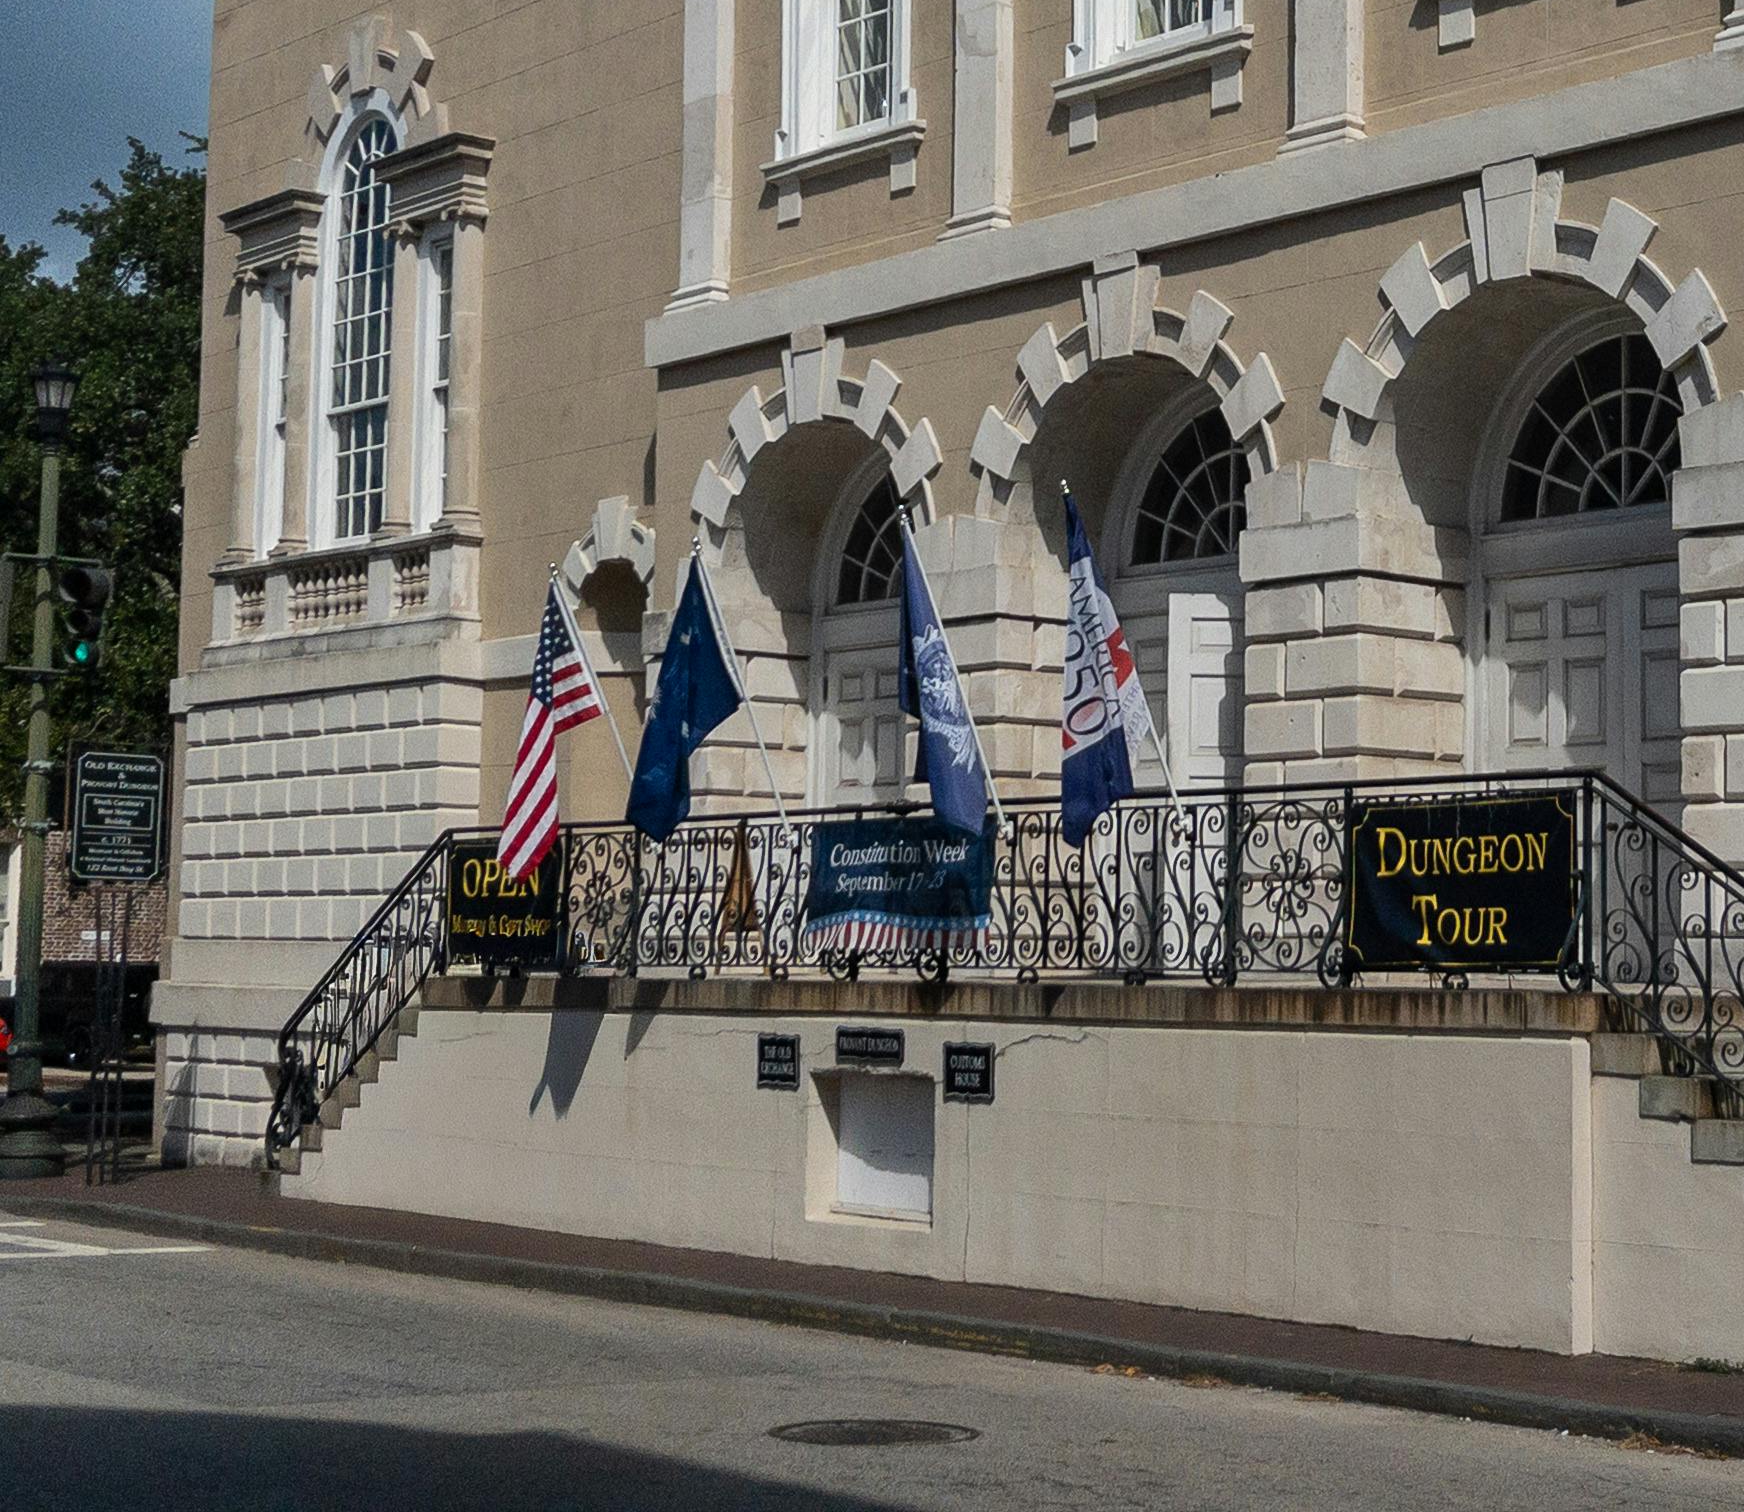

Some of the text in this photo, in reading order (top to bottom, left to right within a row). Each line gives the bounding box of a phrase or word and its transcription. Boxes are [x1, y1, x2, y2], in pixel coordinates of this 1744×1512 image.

[830, 837, 971, 868] Constitution Week
[1376, 827, 1549, 878] DUNGEON
[463, 858, 541, 898] OPEN
[835, 872, 906, 897] September
[1412, 894, 1508, 946] TOUR
